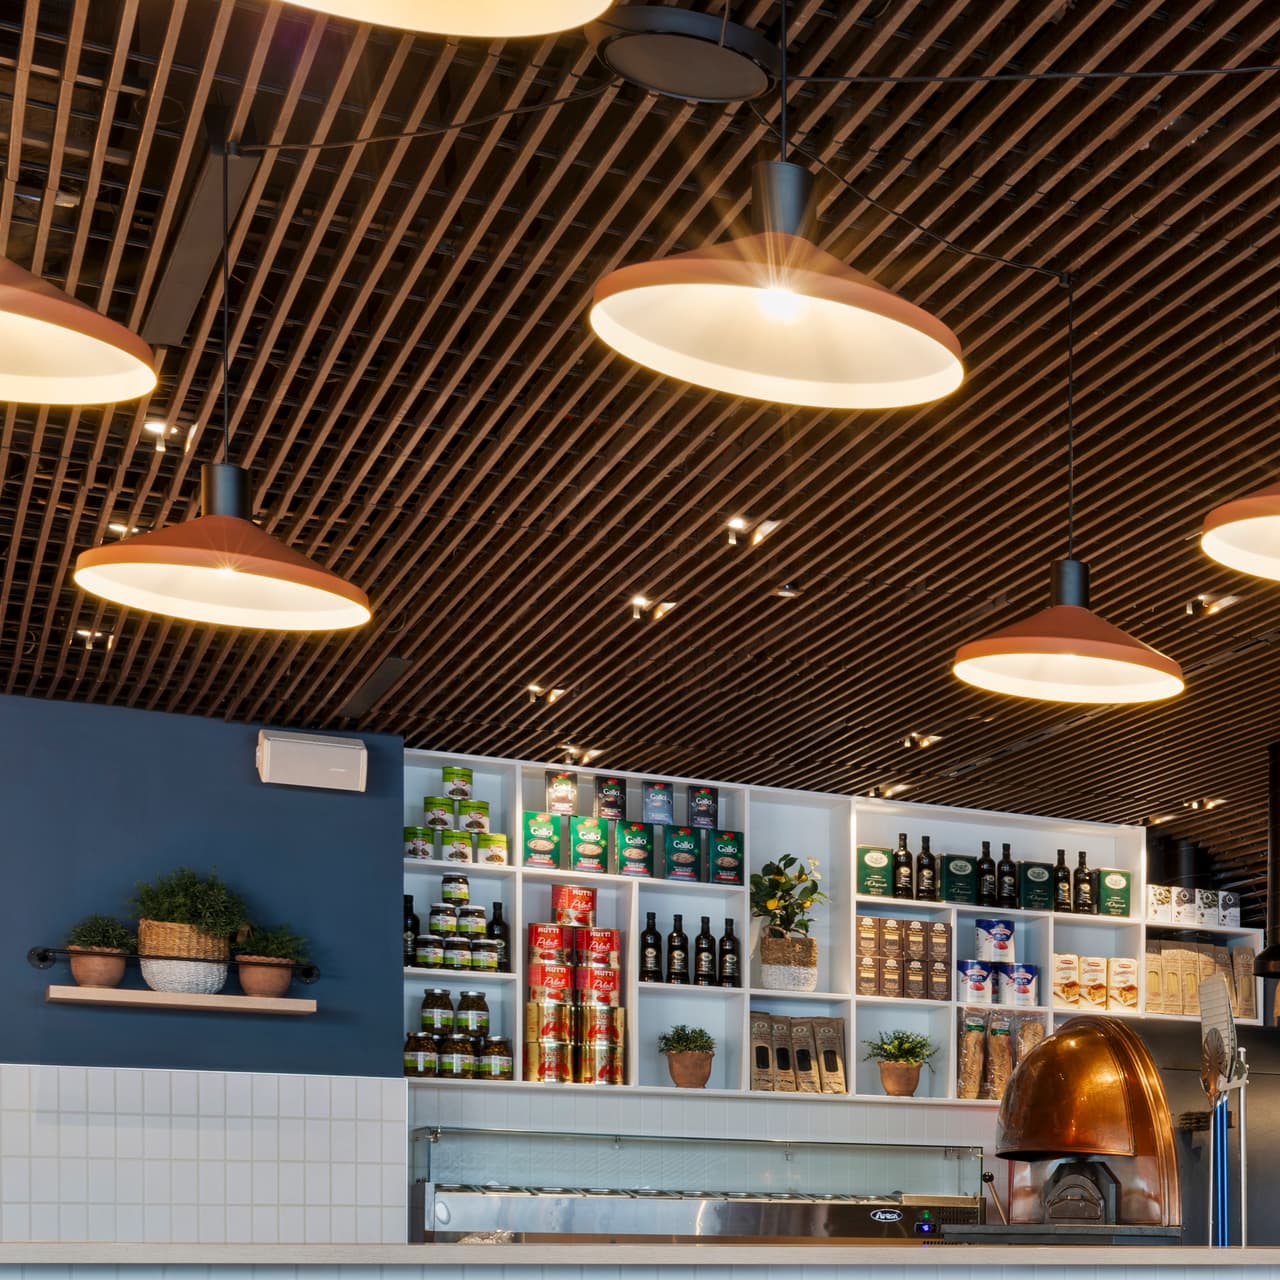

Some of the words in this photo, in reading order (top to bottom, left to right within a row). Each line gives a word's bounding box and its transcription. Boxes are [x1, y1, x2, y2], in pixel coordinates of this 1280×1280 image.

[530, 826, 553, 837] Gallo
[579, 831, 600, 841] Gallo
[625, 835, 647, 845] Gallo
[673, 840, 694, 850] Gallo
[717, 844, 737, 854] Gallo
